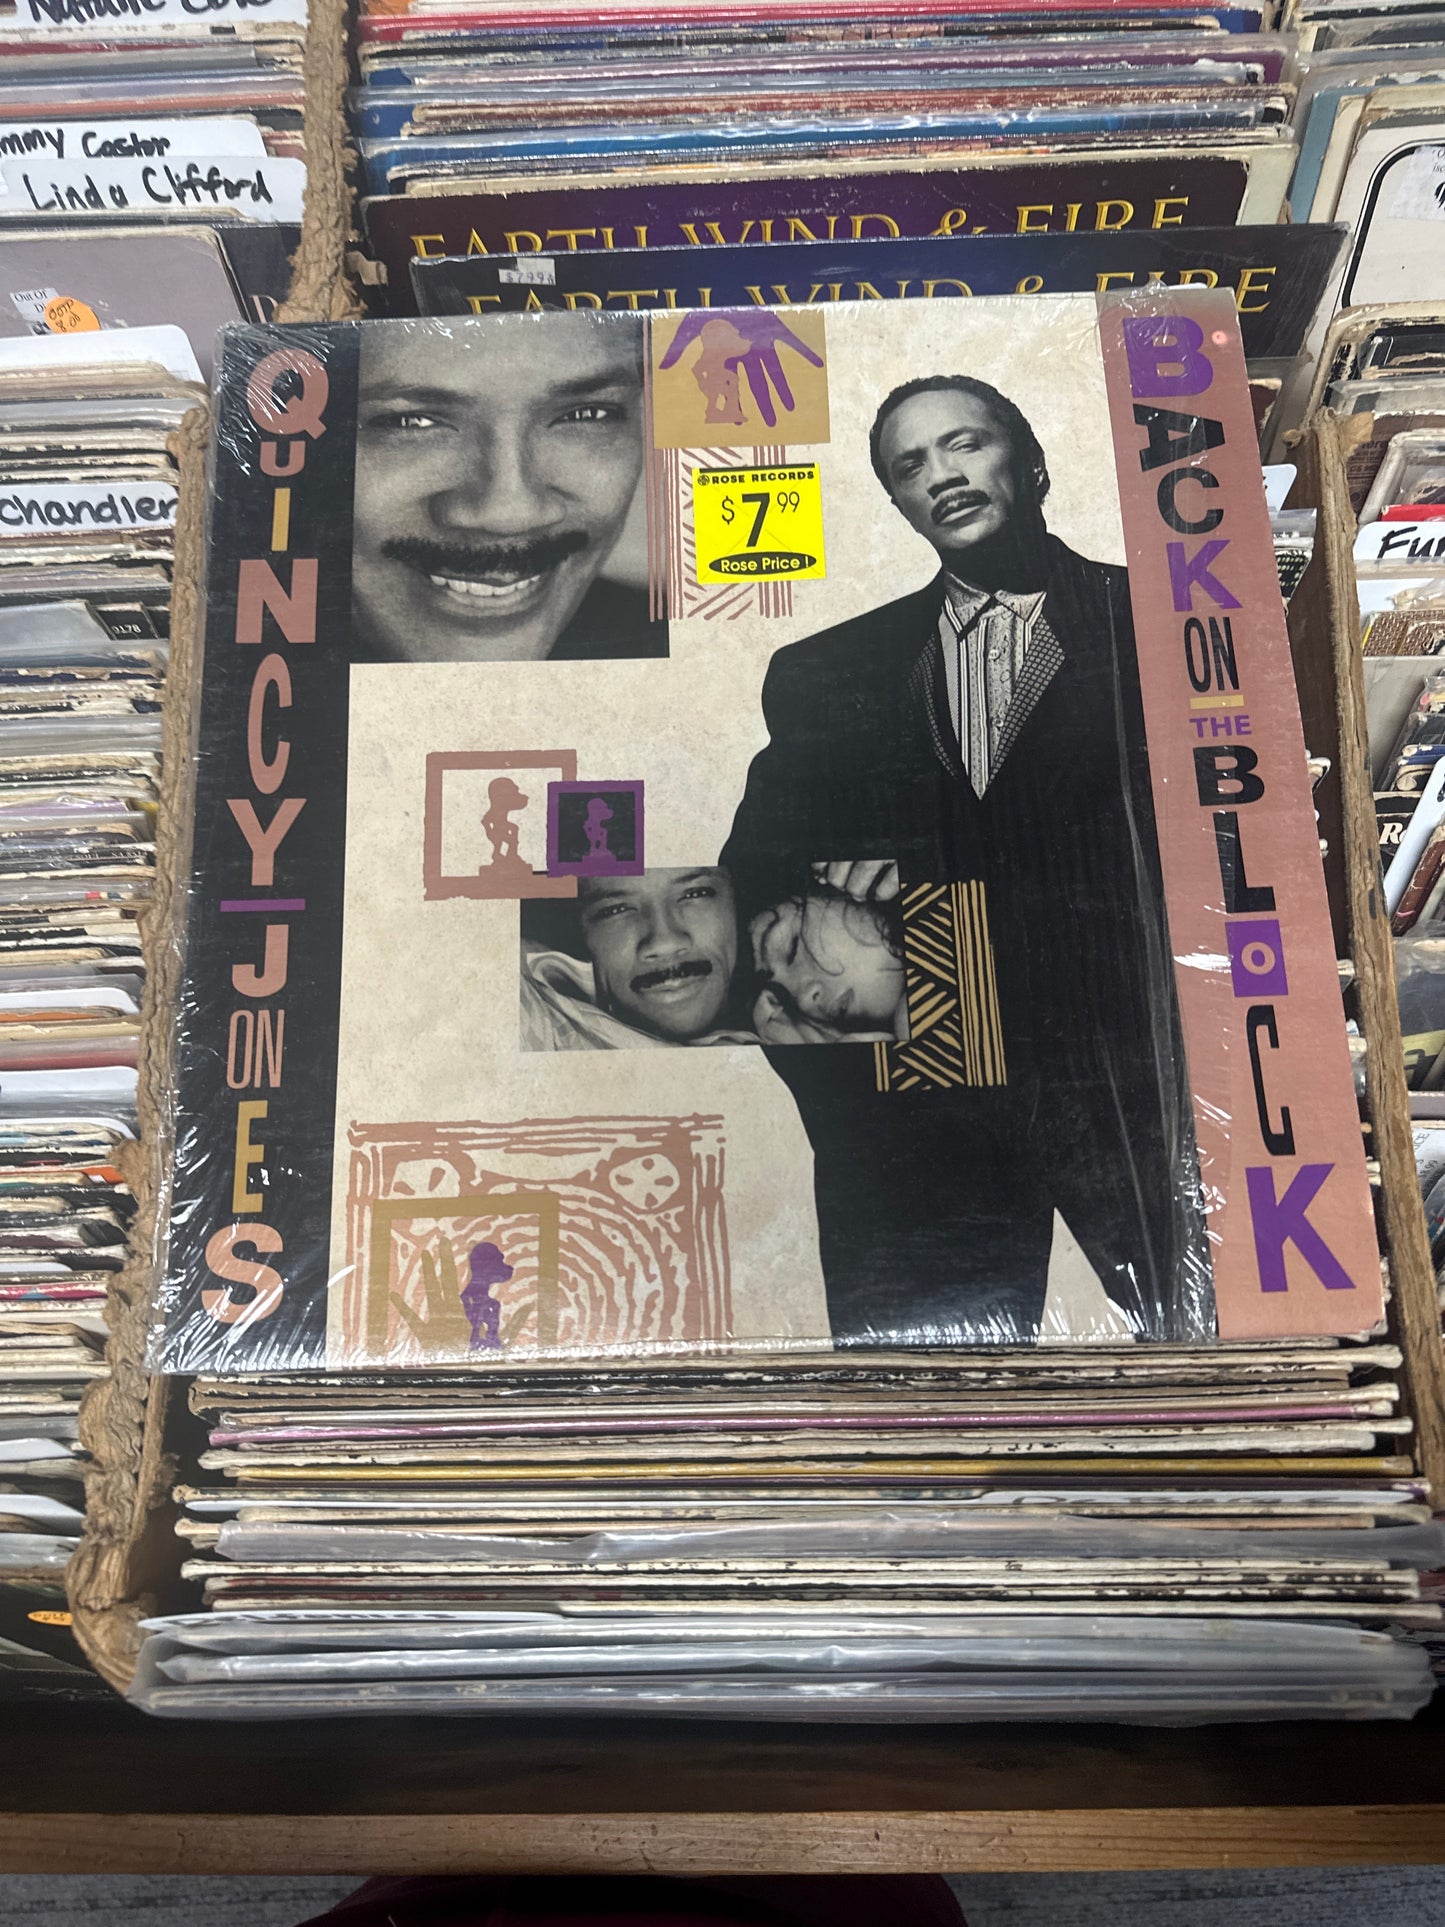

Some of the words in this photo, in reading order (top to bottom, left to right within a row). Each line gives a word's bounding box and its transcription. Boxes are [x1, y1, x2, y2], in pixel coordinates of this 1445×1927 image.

[22, 172, 129, 210] Linda
[141, 162, 274, 205] Clifford
[711, 474, 746, 485] ROSE
[751, 470, 815, 483] RECORDS
[1122, 315, 1244, 612] BACK
[720, 559, 758, 572] Rose
[226, 348, 330, 886] QUINCY
[1184, 616, 1240, 693] ON
[1189, 715, 1253, 739] THE
[1192, 744, 1357, 1293] BLOCK
[201, 923, 291, 1324] JONES
